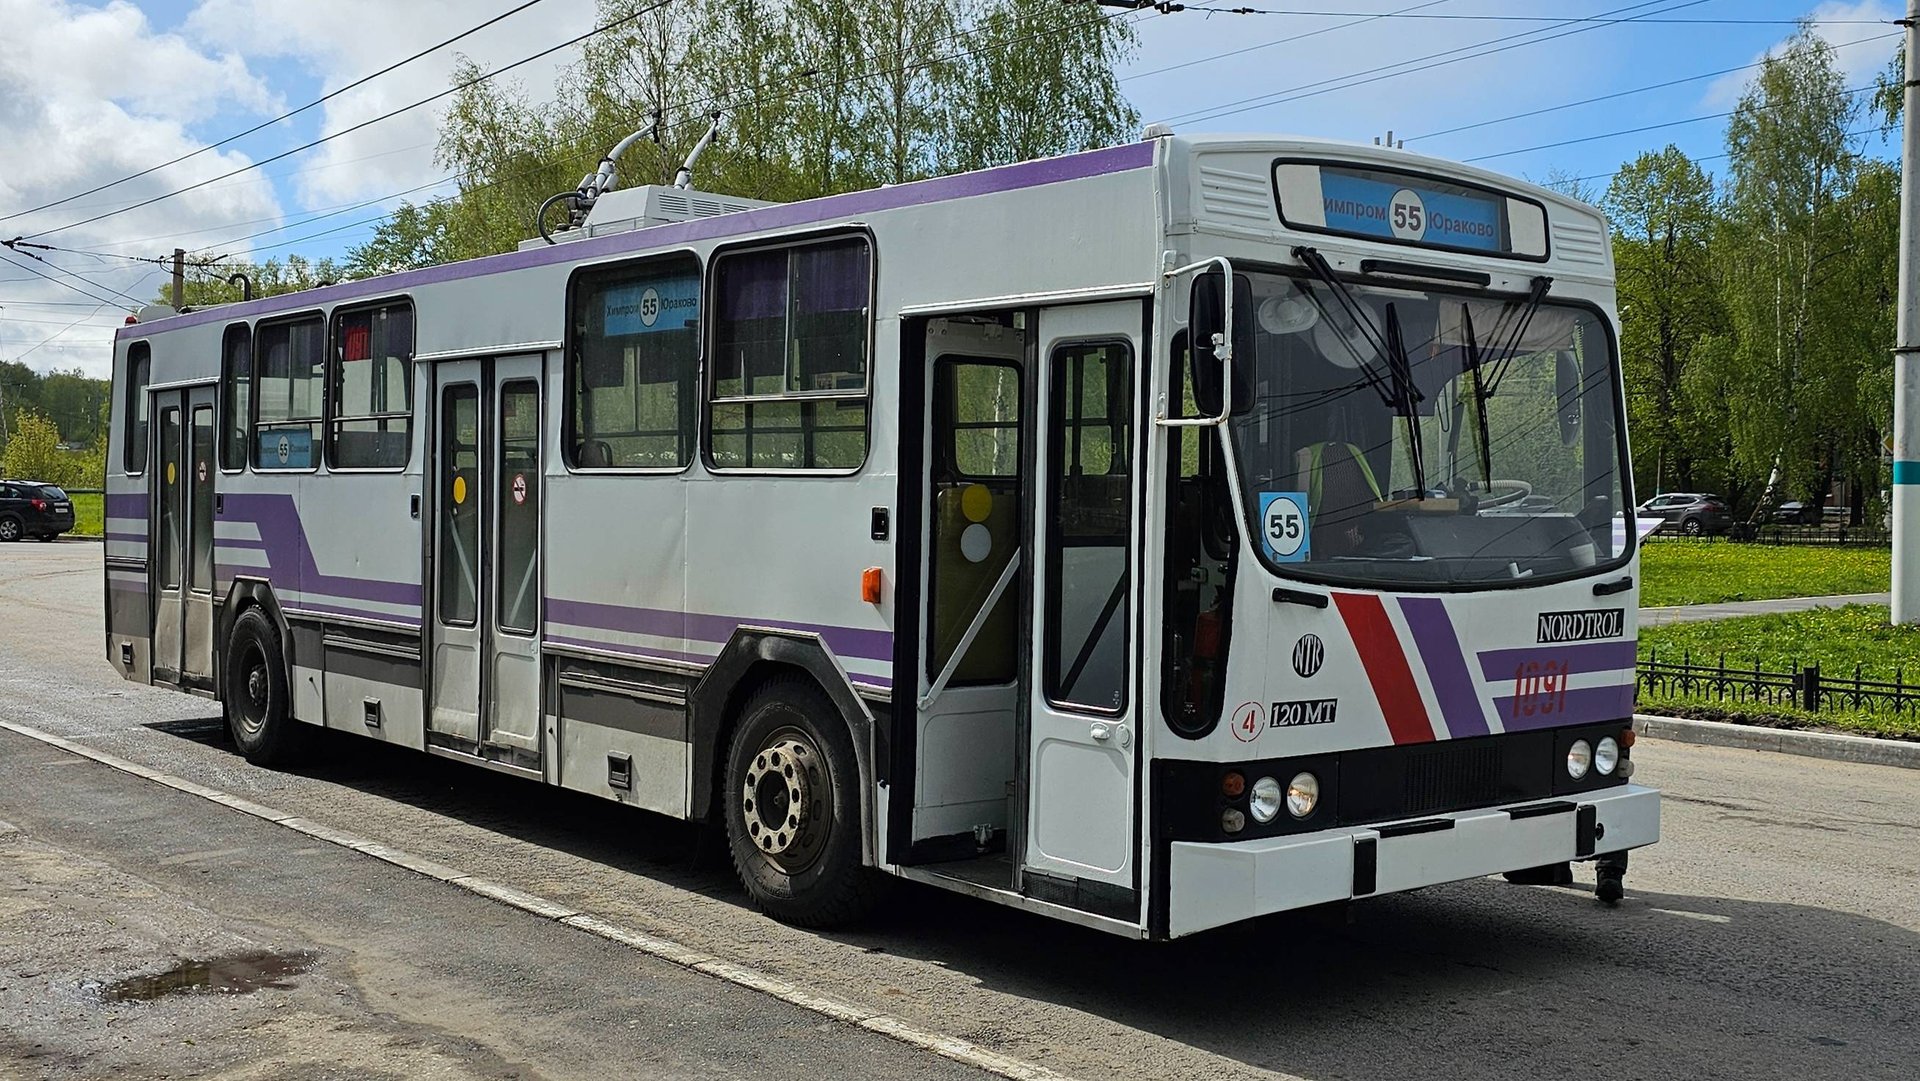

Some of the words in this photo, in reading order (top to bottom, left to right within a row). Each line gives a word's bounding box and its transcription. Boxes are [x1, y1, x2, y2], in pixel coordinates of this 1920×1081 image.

[1324, 198, 1385, 220] импром
[1394, 203, 1422, 232] 55
[1429, 211, 1494, 238] Юраково
[642, 298, 657, 316] 55
[661, 297, 697, 312] Юраково
[280, 443, 288, 456] 55
[1270, 514, 1300, 539] 55
[1538, 611, 1622, 642] NORDTROL
[1294, 634, 1321, 675] NTR
[1513, 659, 1569, 718] 1091
[1242, 709, 1256, 733] 4
[1271, 703, 1301, 727] 120
[1303, 700, 1336, 724] MT
